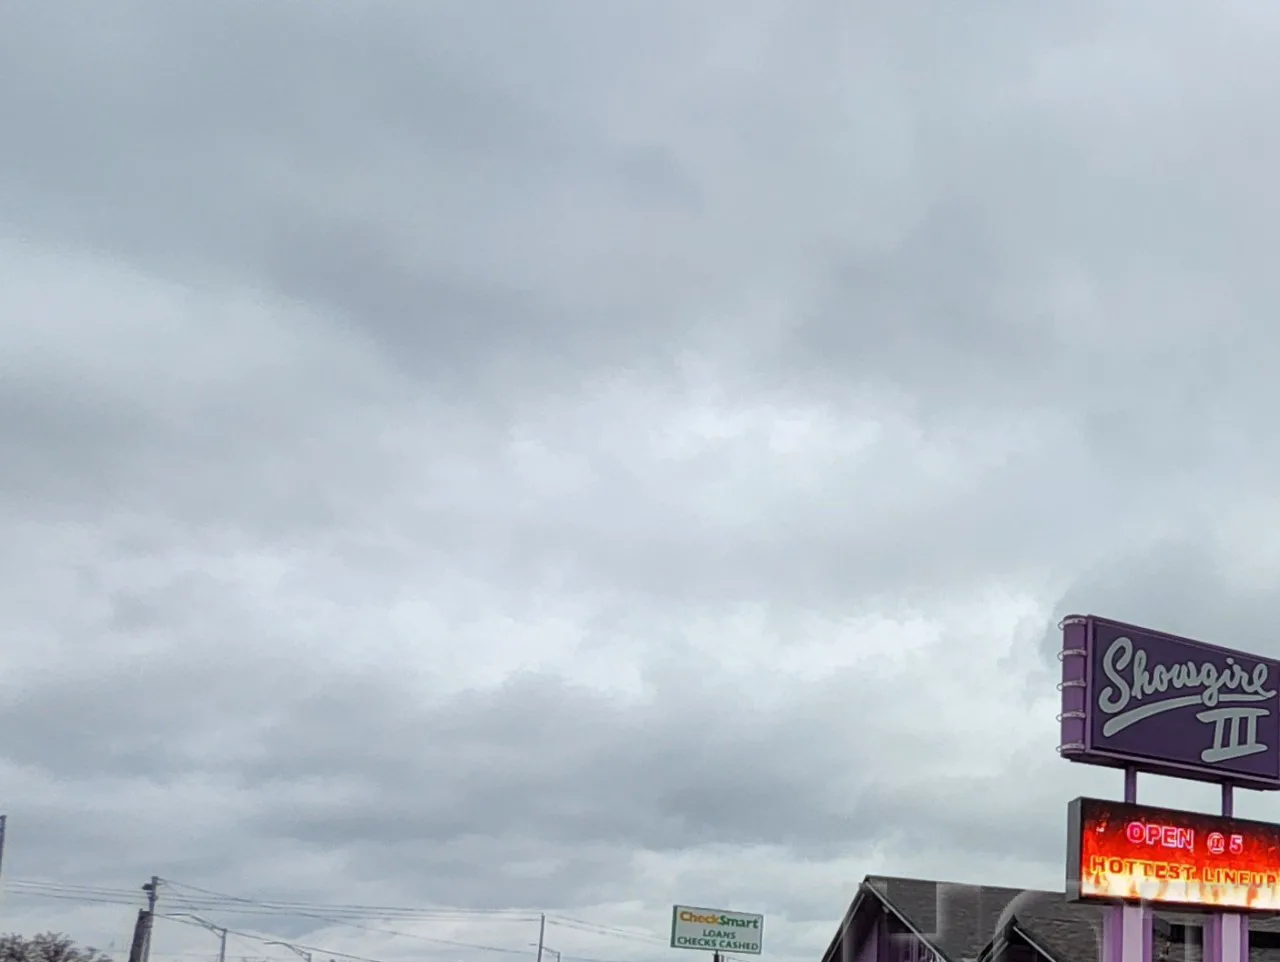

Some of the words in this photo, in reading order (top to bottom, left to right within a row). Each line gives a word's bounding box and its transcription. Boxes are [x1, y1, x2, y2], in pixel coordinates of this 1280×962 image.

[1195, 706, 1271, 763] III
[1127, 821, 1194, 849] OPEN
[1229, 834, 1243, 854] 5
[1090, 855, 1196, 881] HOTTEST
[1203, 867, 1277, 889] LINEUP
[679, 911, 759, 929] CheckSmart
[677, 936, 717, 948] CHECKS
[719, 939, 759, 951] CASHED
[702, 928, 736, 940] LOANS
